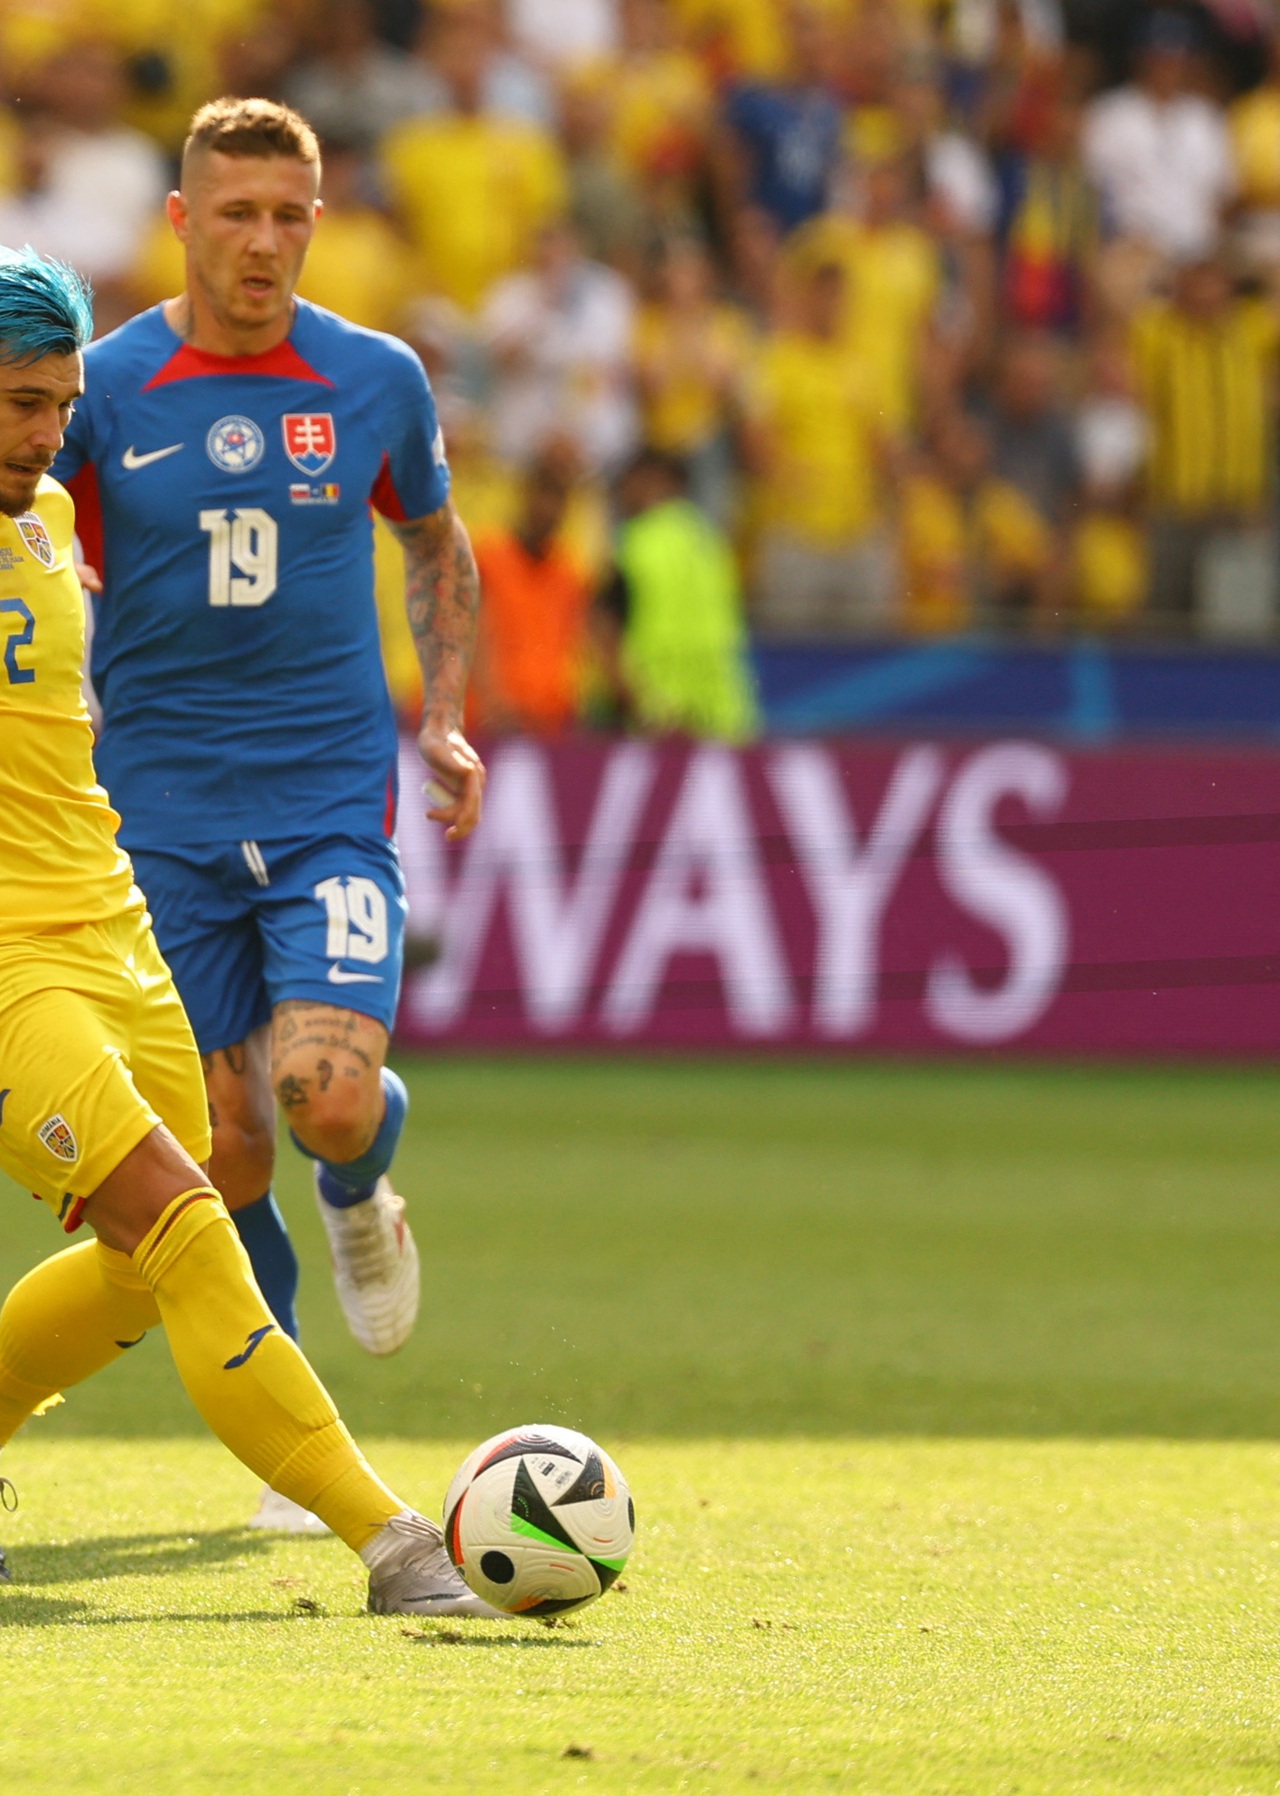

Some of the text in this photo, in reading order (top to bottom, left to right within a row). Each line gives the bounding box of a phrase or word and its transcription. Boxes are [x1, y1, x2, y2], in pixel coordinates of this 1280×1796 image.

[199, 507, 279, 607] 19
[314, 875, 389, 964] 19
[396, 741, 1071, 1046] WAYS
